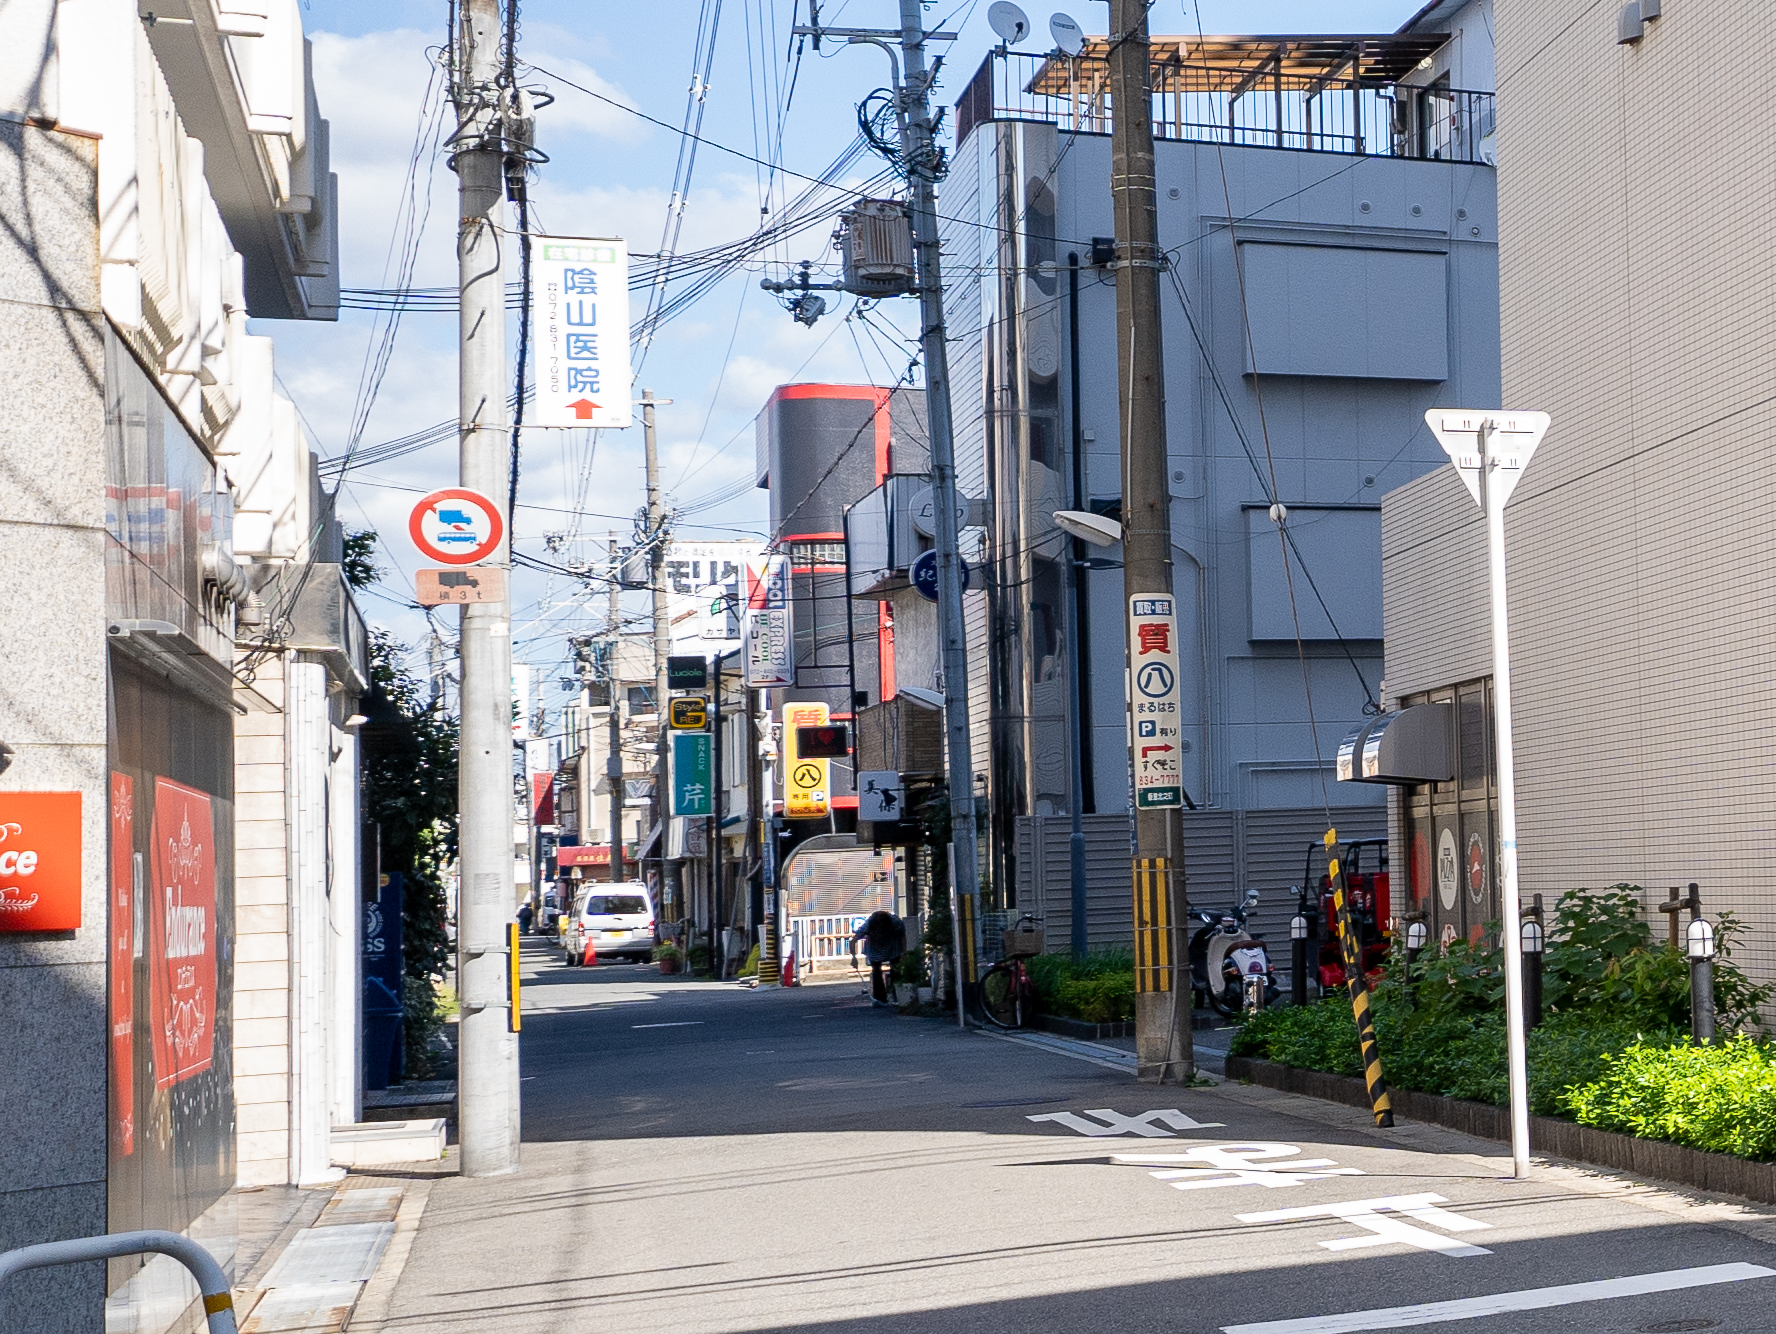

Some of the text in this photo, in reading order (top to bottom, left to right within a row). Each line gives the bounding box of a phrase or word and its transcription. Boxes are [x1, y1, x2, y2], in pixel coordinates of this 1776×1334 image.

[563, 267, 601, 394] 陰山医院
[1137, 622, 1171, 655] 質
[1137, 702, 1176, 713] まるはち
[1141, 723, 1153, 736] P
[165, 885, 206, 959] Endurance
